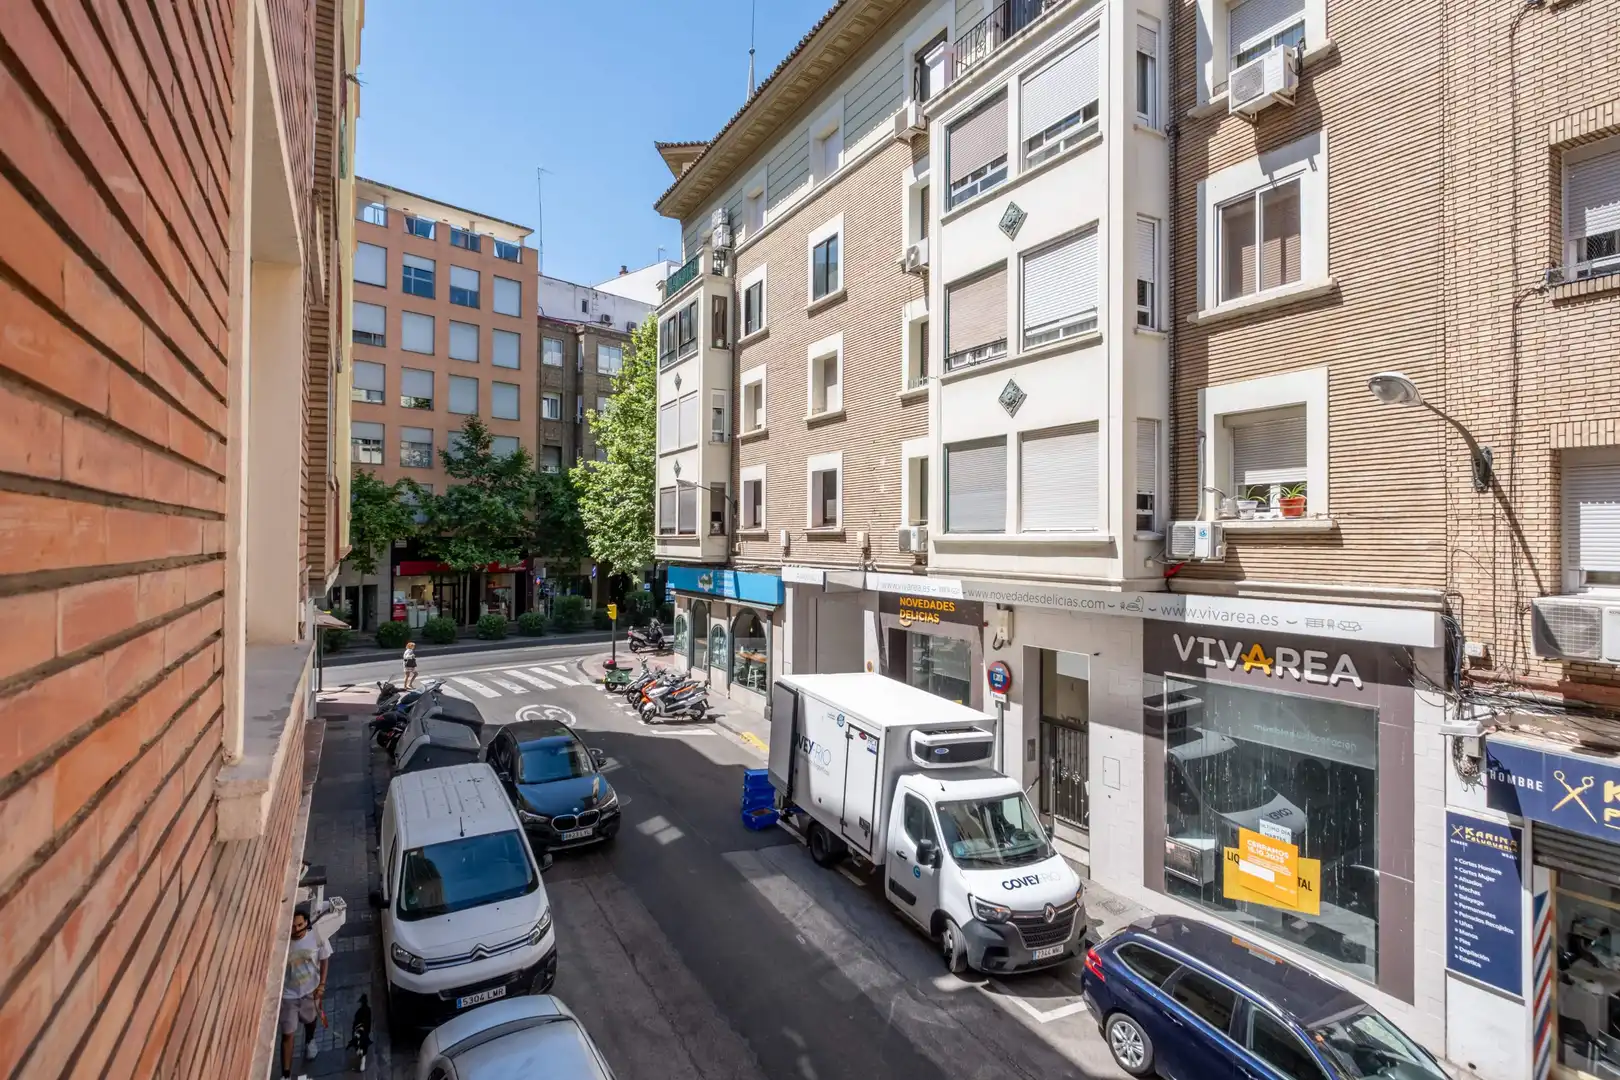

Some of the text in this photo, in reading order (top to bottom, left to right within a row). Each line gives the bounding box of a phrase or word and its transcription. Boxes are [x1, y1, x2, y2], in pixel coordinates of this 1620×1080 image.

[900, 596, 955, 612] NOVEDADES
[968, 588, 1105, 610] www.novedadesdelicias.com
[1160, 603, 1279, 627] www.vivarea.es
[1173, 633, 1364, 690] VIVAREA
[1489, 769, 1545, 792] HOMBRE
[1246, 839, 1289, 859] CERRAMOS
[1478, 863, 1502, 875] Hombre
[1297, 877, 1312, 891] TAL
[1459, 884, 1481, 896] Mechas
[463, 987, 504, 1006] 5304 LMR
